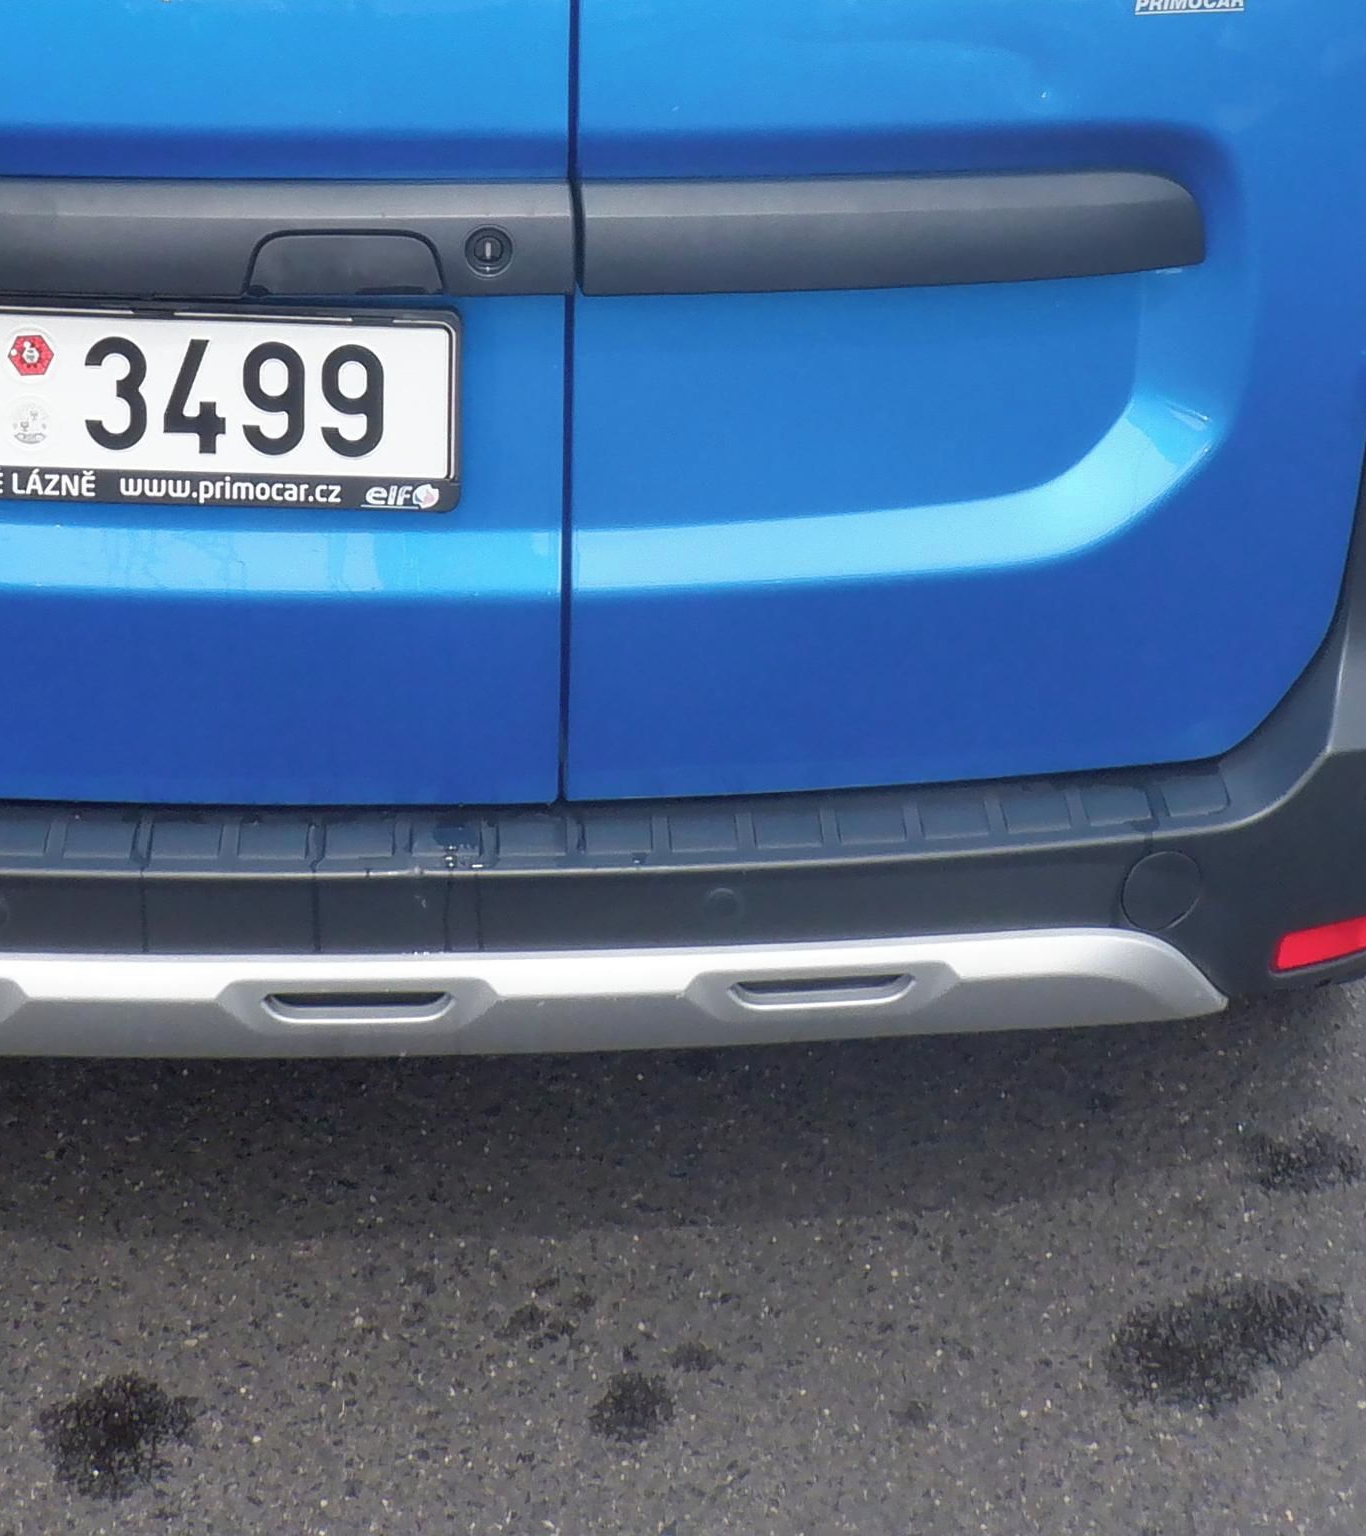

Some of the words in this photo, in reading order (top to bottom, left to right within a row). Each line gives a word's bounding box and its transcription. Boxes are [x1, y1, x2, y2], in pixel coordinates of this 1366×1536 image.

[84, 335, 385, 458] 3499
[11, 468, 97, 498] LÁZNĚ
[119, 475, 342, 505] www.primocar.cz
[365, 484, 414, 507] elf
